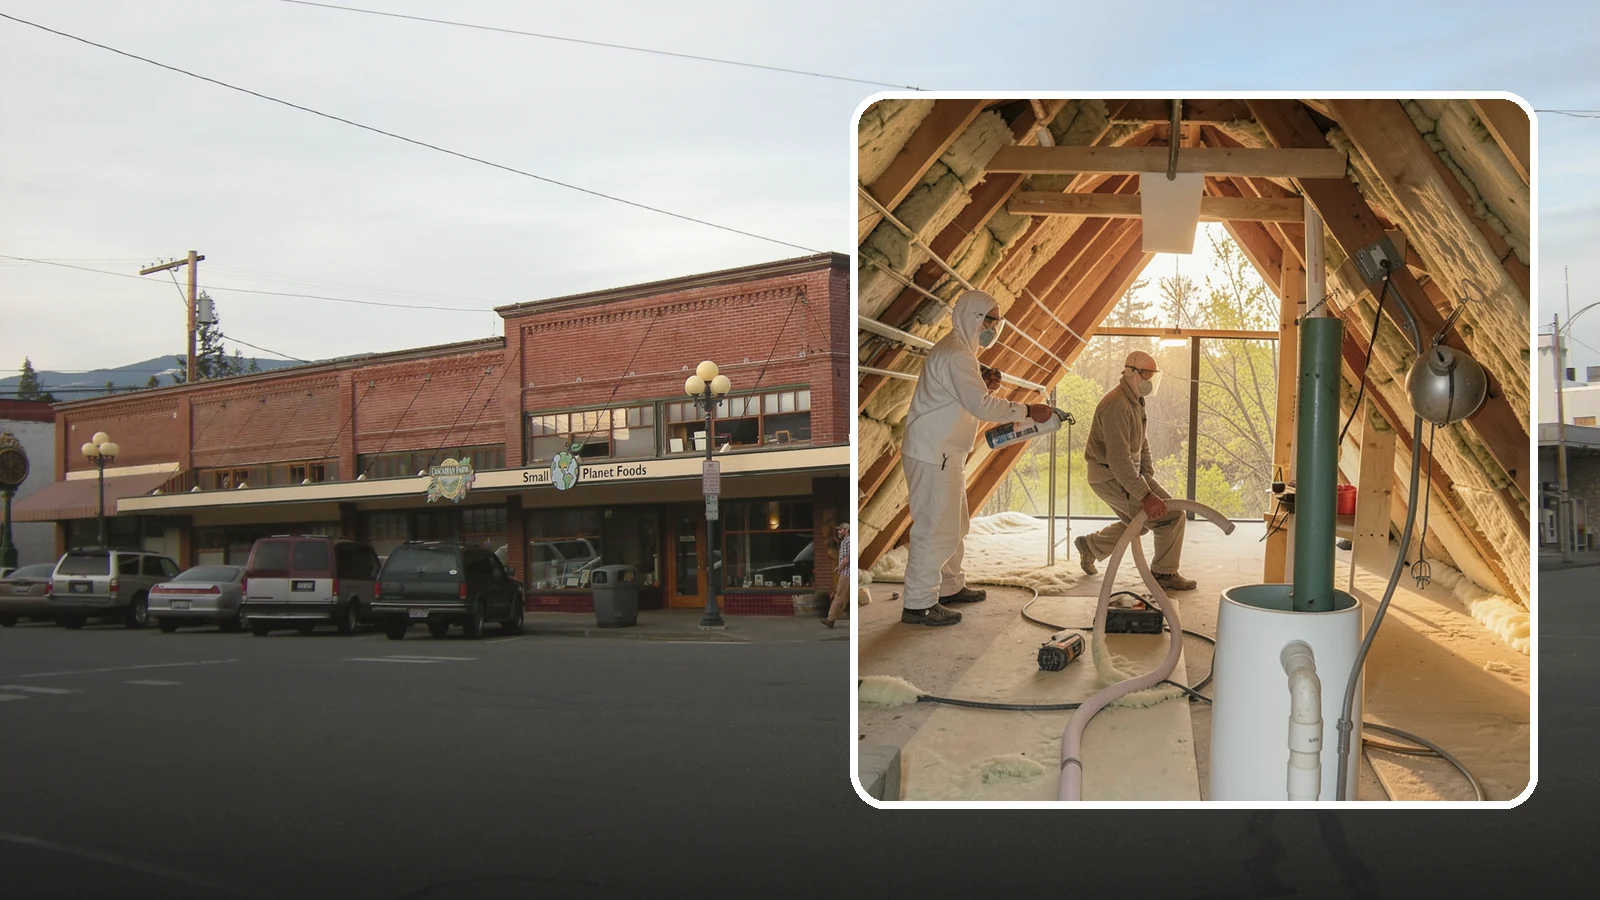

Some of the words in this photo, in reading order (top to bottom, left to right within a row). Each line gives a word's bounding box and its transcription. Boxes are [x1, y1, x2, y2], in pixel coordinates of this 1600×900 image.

[523, 471, 549, 483] Small
[583, 467, 614, 479] Planet
[617, 464, 647, 477] Foods
